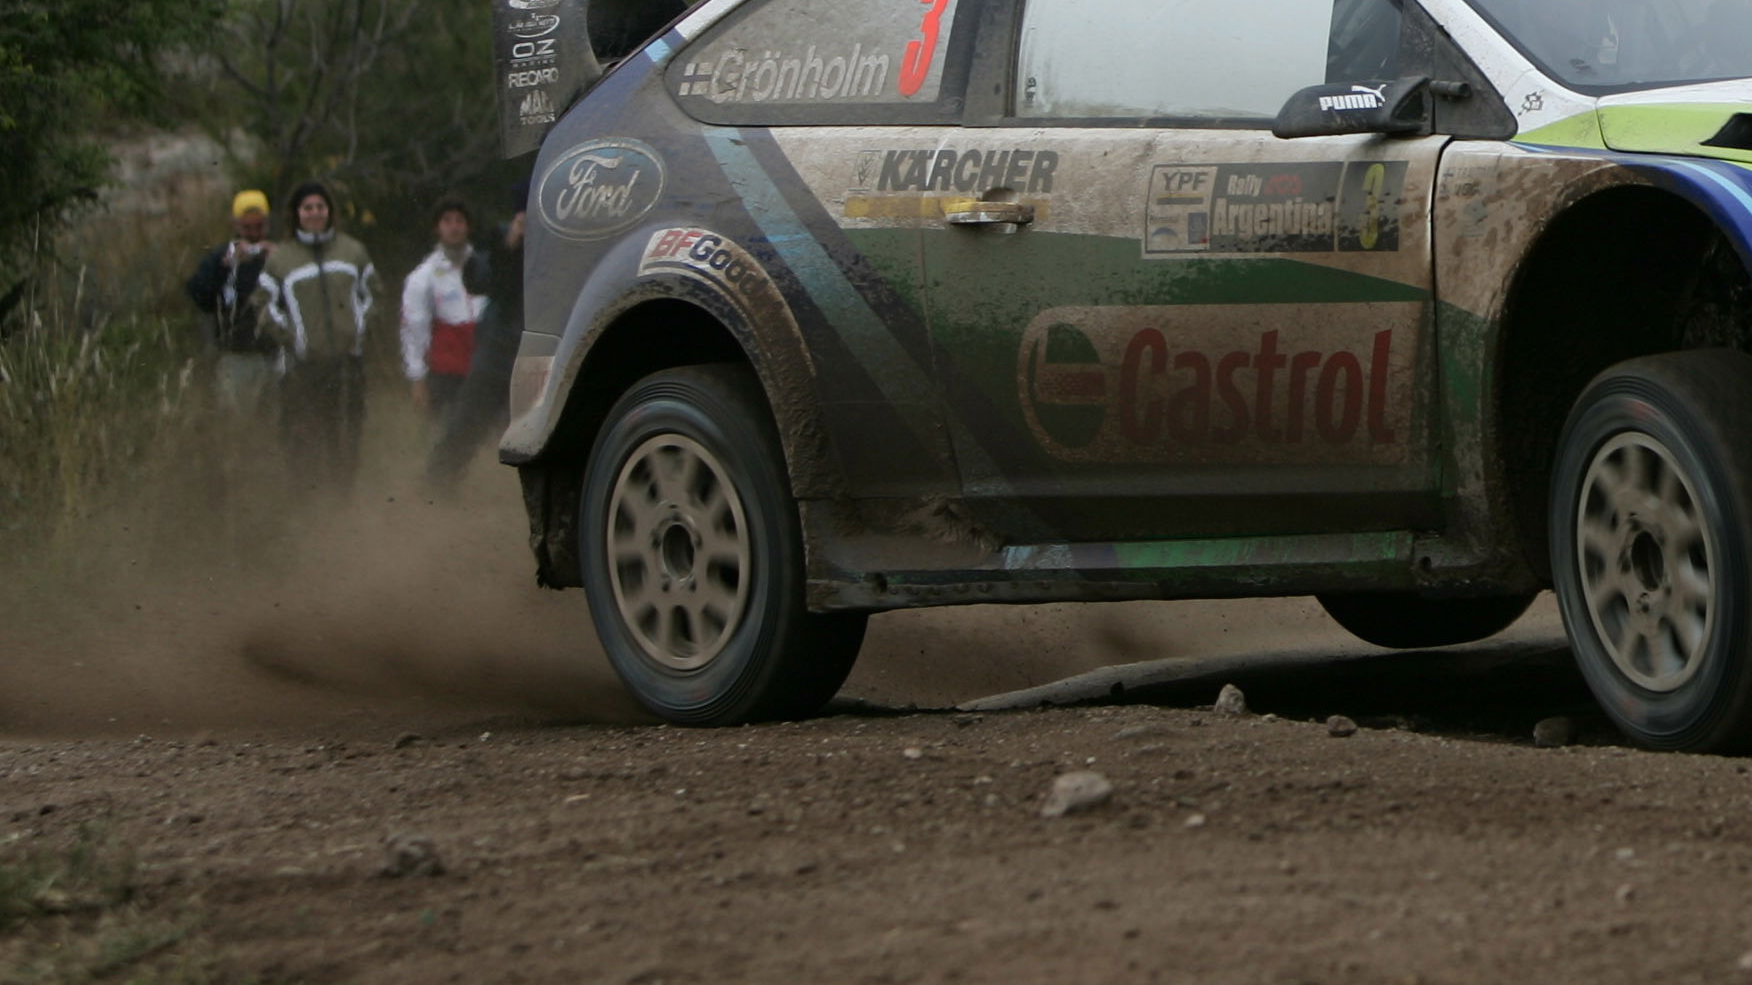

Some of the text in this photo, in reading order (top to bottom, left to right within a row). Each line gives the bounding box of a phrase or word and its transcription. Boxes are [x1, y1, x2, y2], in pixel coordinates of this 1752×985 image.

[512, 39, 556, 58] OZ
[508, 68, 559, 88] RECARO
[708, 44, 890, 104] Grönholm
[1319, 94, 1378, 111] PUMA
[556, 155, 634, 222] Ford
[877, 149, 1059, 193] KÄRCHER
[1162, 171, 1209, 191] YPF
[1226, 174, 1263, 198] Rally
[1212, 197, 1334, 238] Argentina
[1359, 163, 1383, 250] 3
[1118, 328, 1396, 448] Castrol
